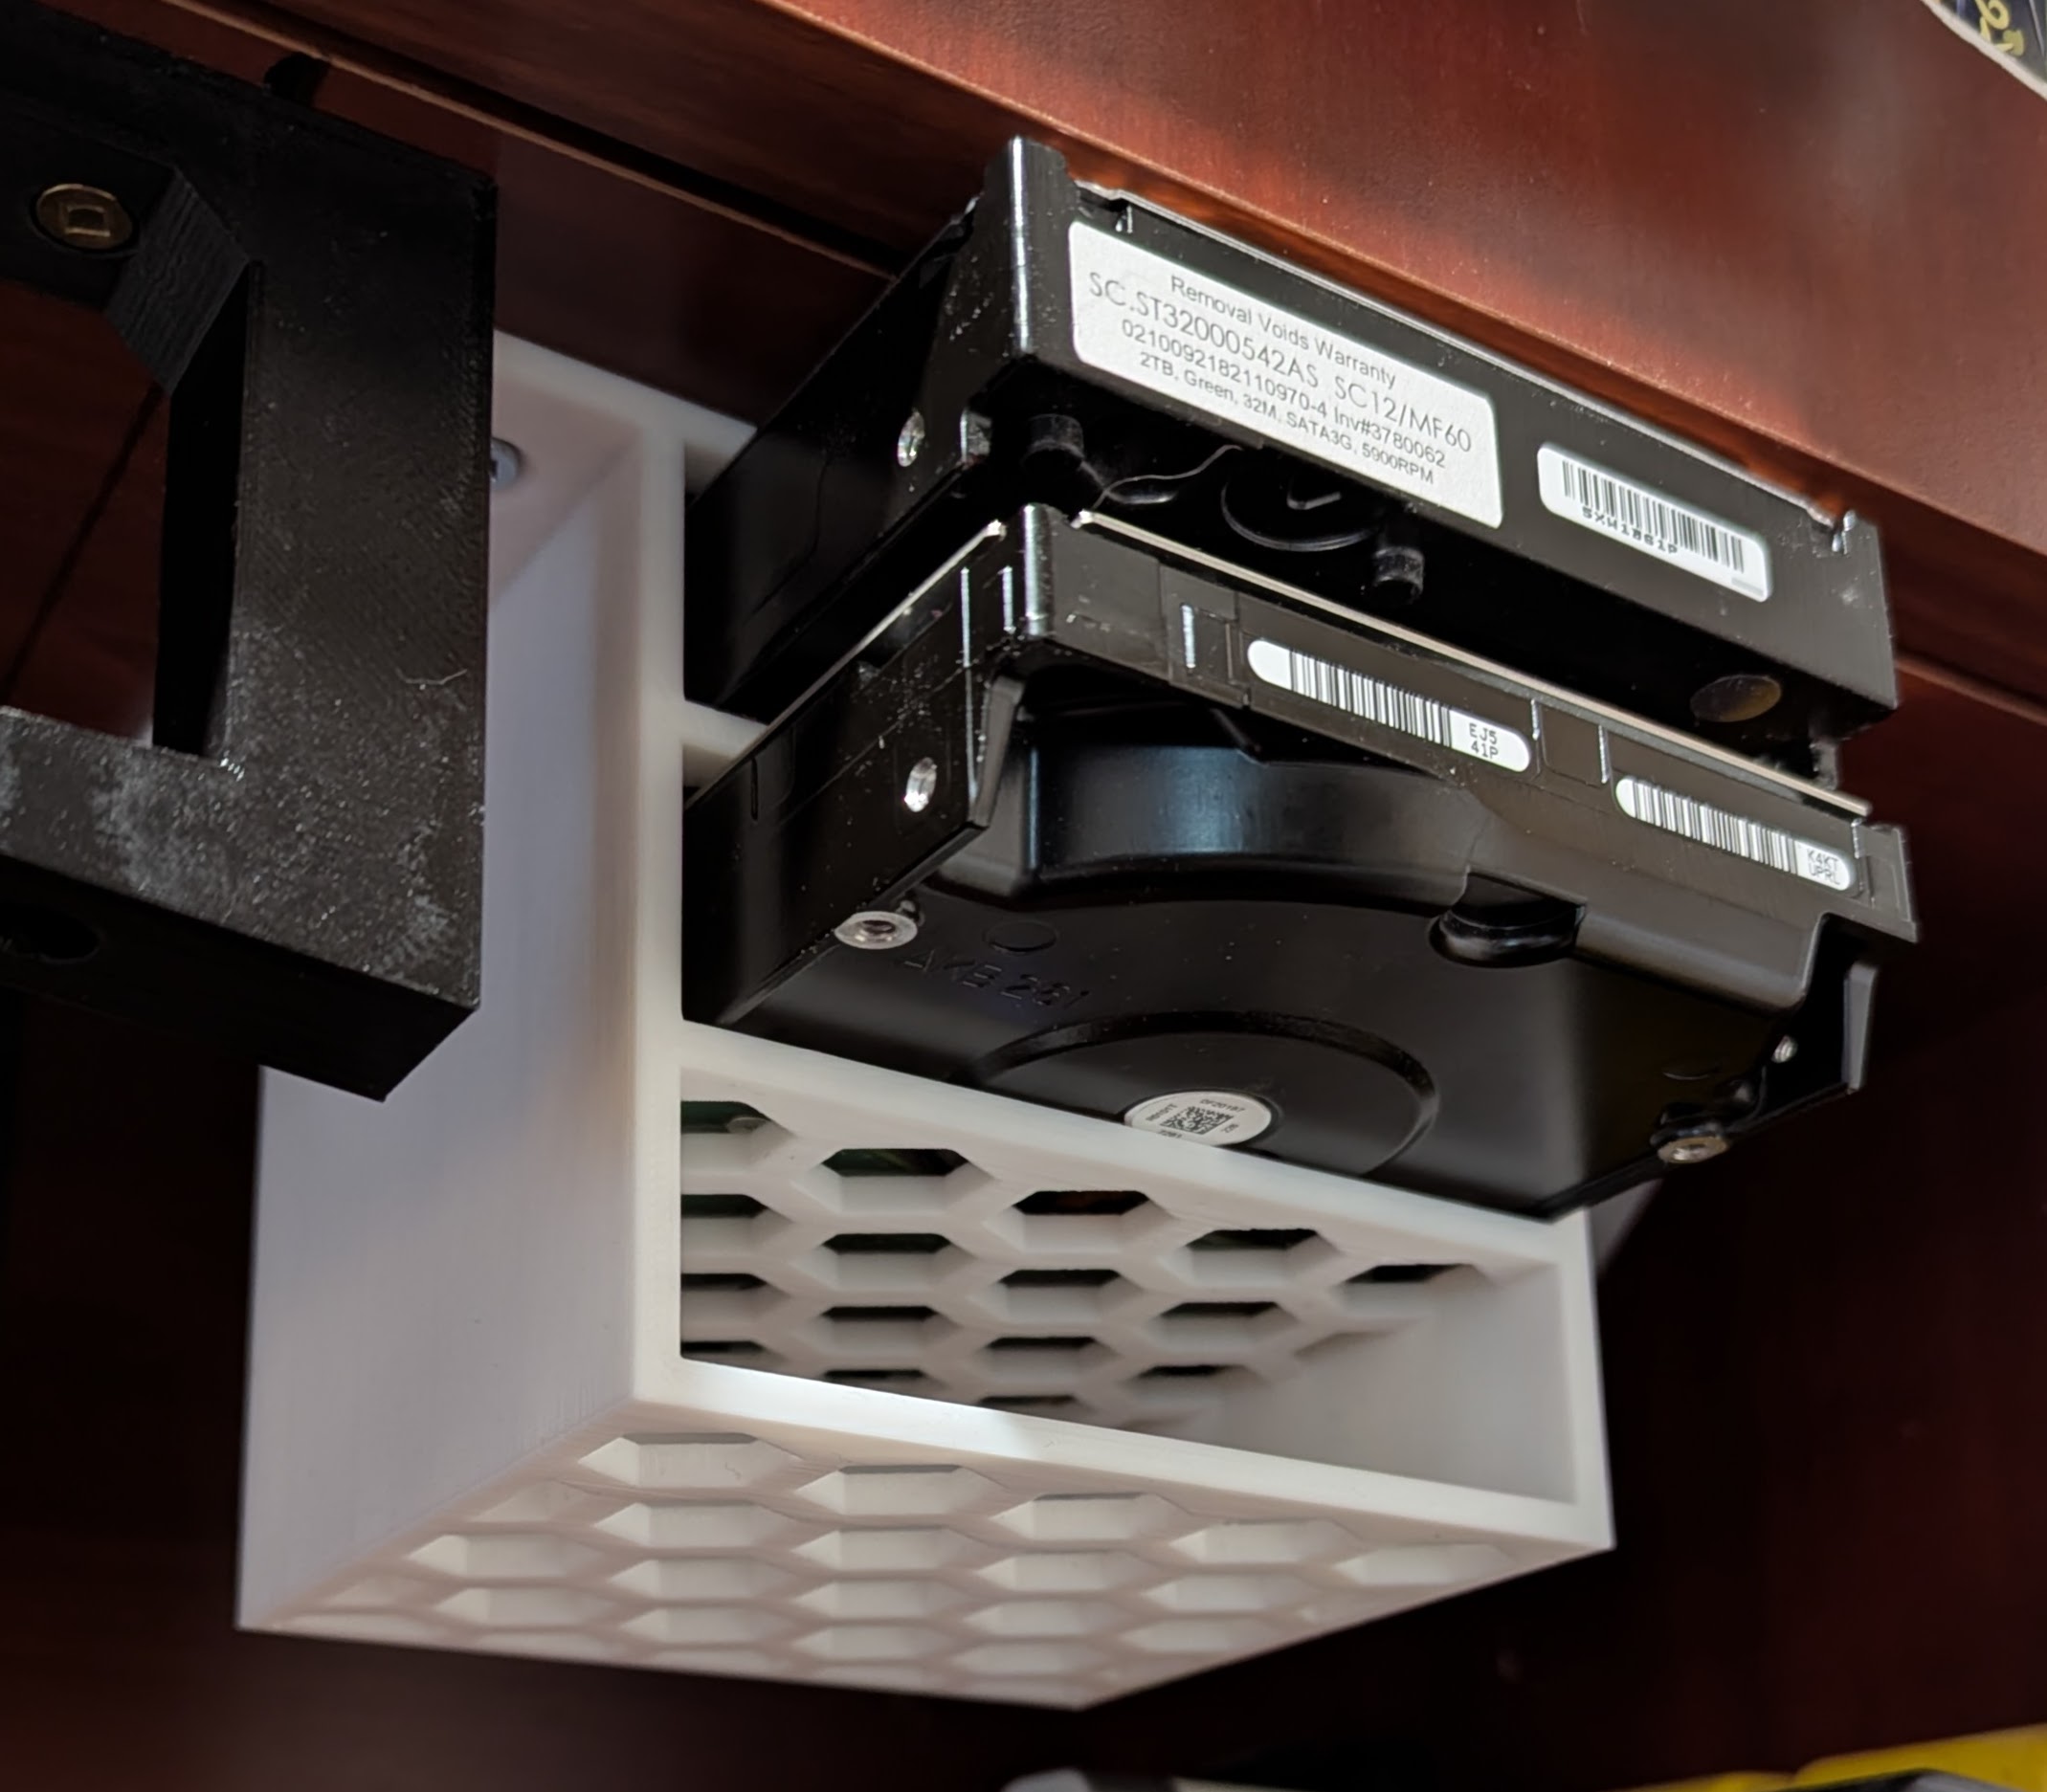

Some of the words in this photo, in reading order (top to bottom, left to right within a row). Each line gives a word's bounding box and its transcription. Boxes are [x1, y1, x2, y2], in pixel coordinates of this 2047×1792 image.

[1088, 271, 1319, 388] SC.ST32000542AS
[1334, 374, 1472, 453] SC12/MF60
[1169, 274, 1253, 325] Removal
[1257, 312, 1309, 350] Voids
[1314, 338, 1396, 390] Warranty
[1121, 319, 1327, 418] 0210092182110970-4
[1333, 406, 1446, 469] Inv#3780062
[1361, 442, 1435, 484] 5900RPM
[1468, 722, 1498, 744] EJ5
[1470, 741, 1499, 760] 41P
